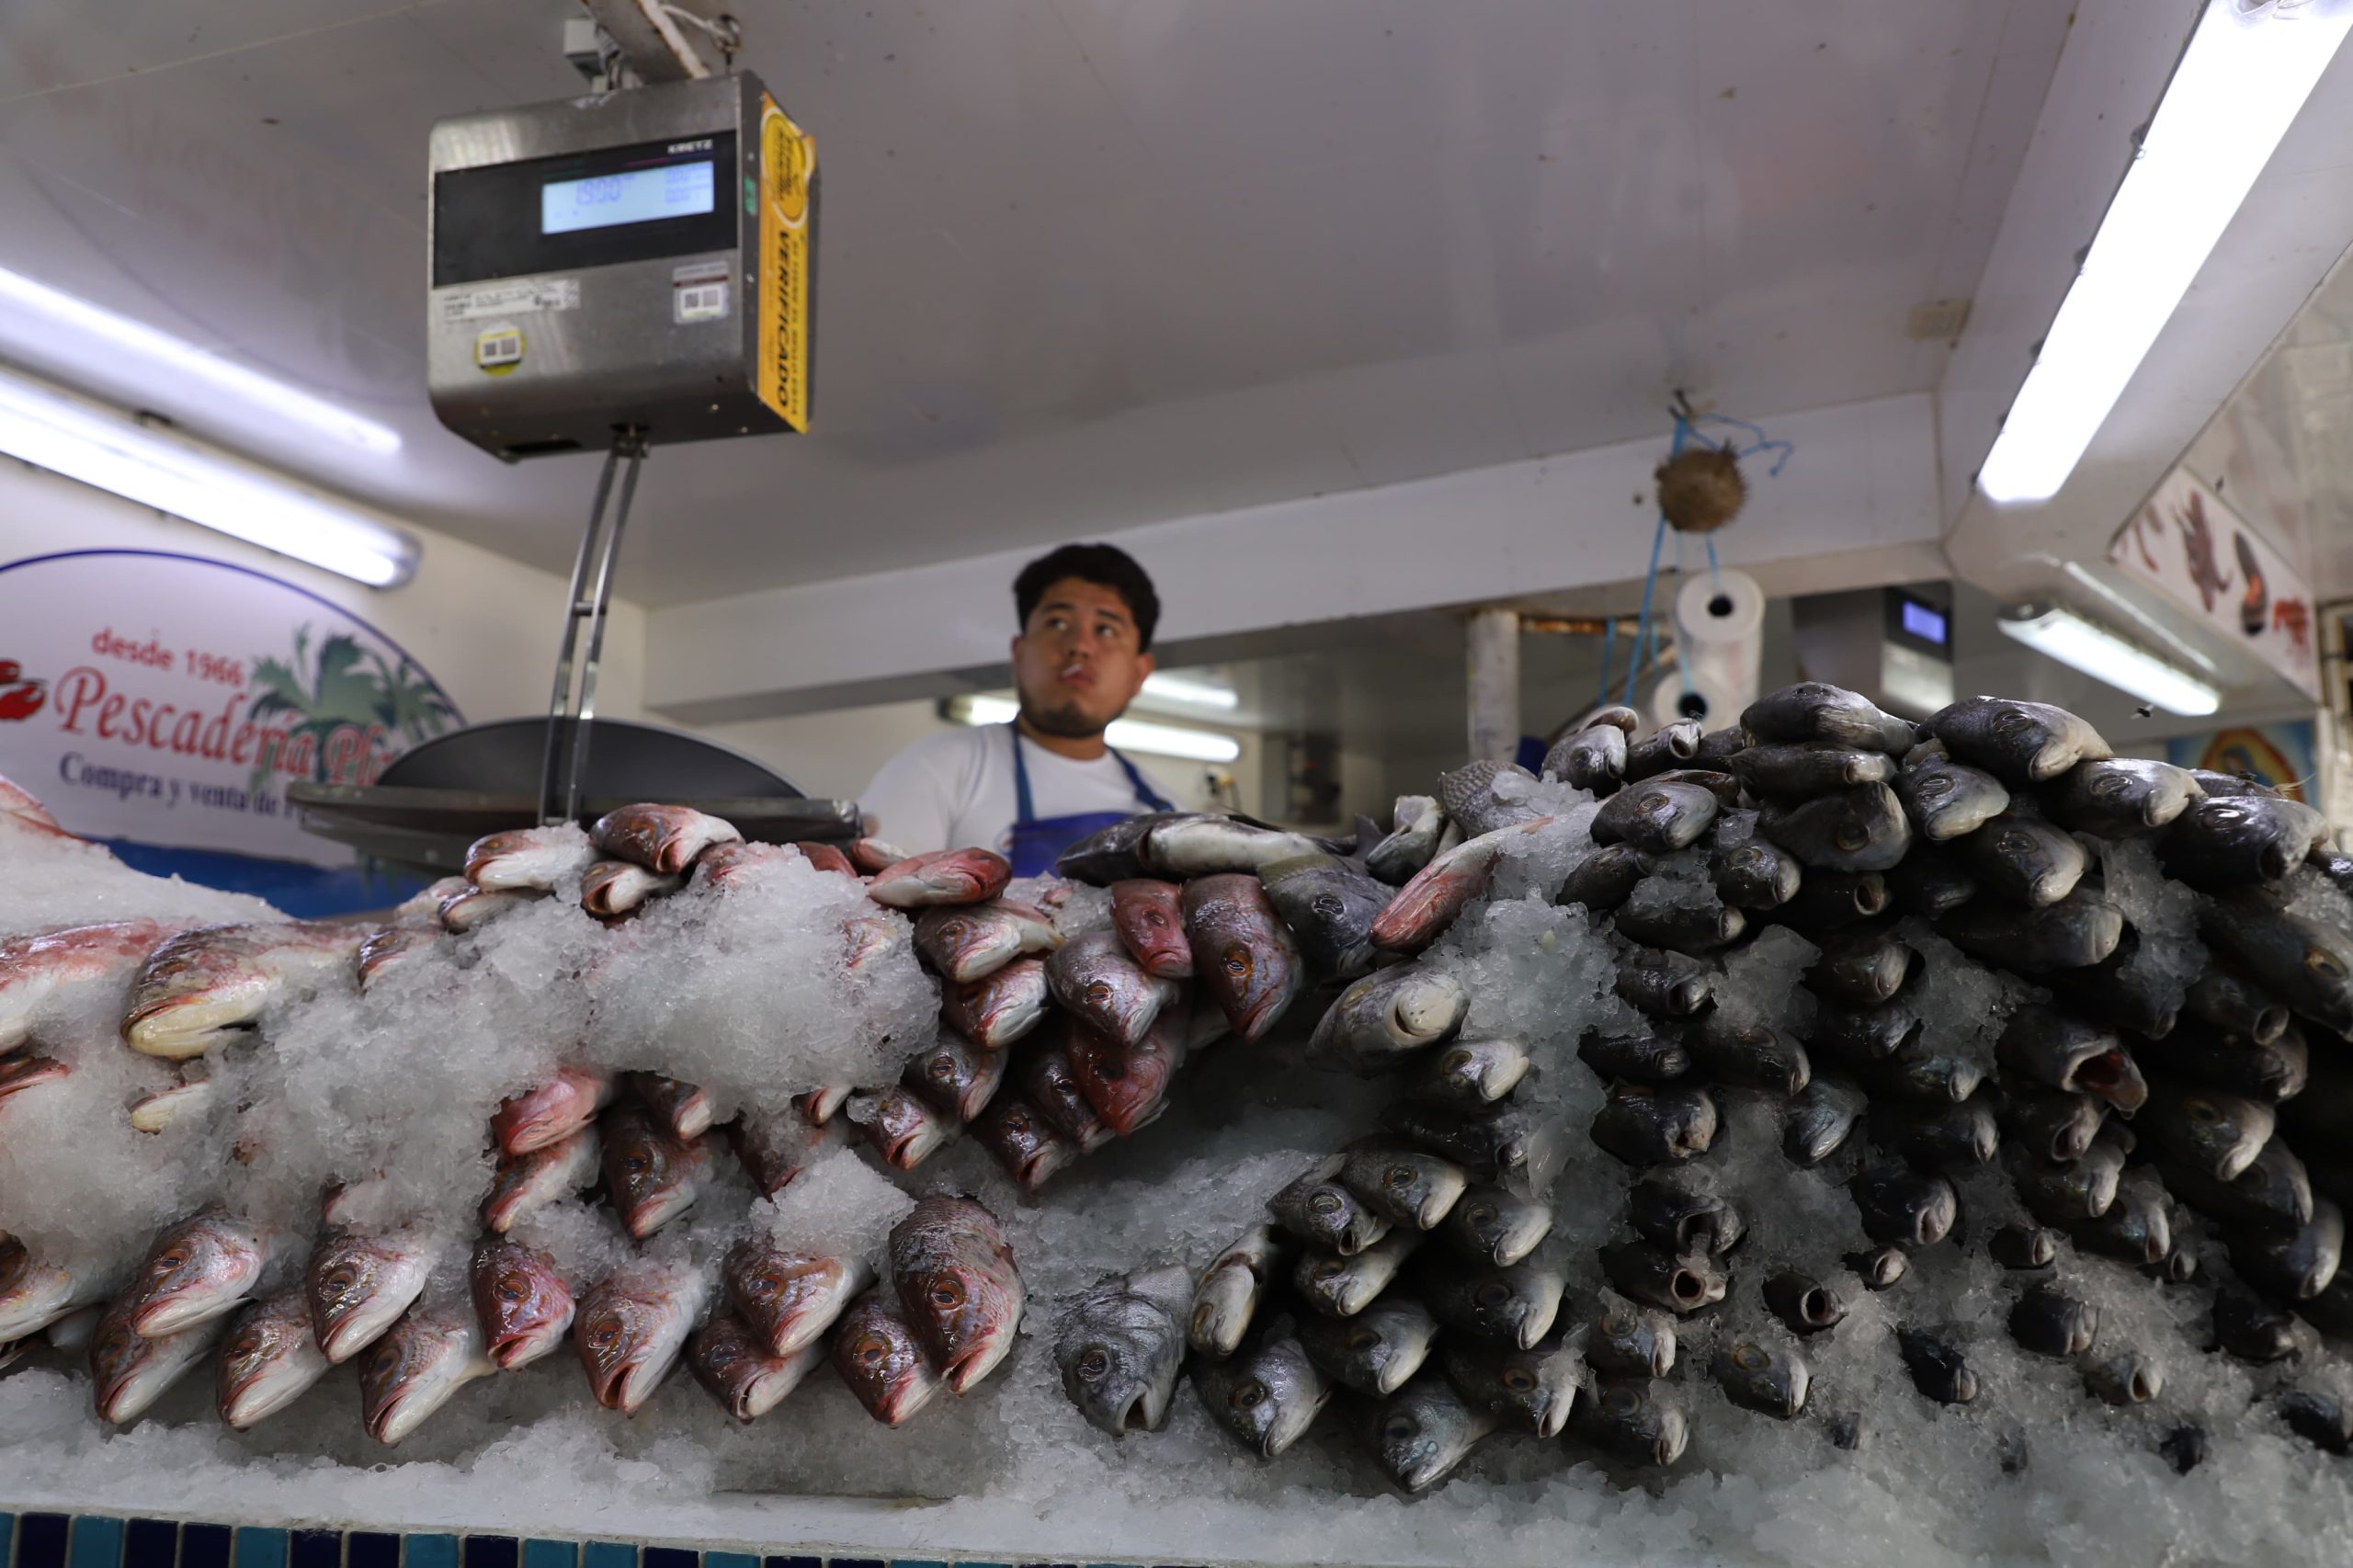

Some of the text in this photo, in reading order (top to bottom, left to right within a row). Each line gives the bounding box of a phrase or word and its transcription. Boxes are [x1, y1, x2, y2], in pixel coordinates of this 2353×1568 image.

[778, 232, 790, 407] VERIFICADO
[91, 625, 244, 687] desde 1966
[53, 665, 315, 777] Pescadería
[59, 750, 163, 801] Compra
[165, 778, 180, 809] y
[188, 782, 248, 812] venta
[253, 789, 279, 818] de
